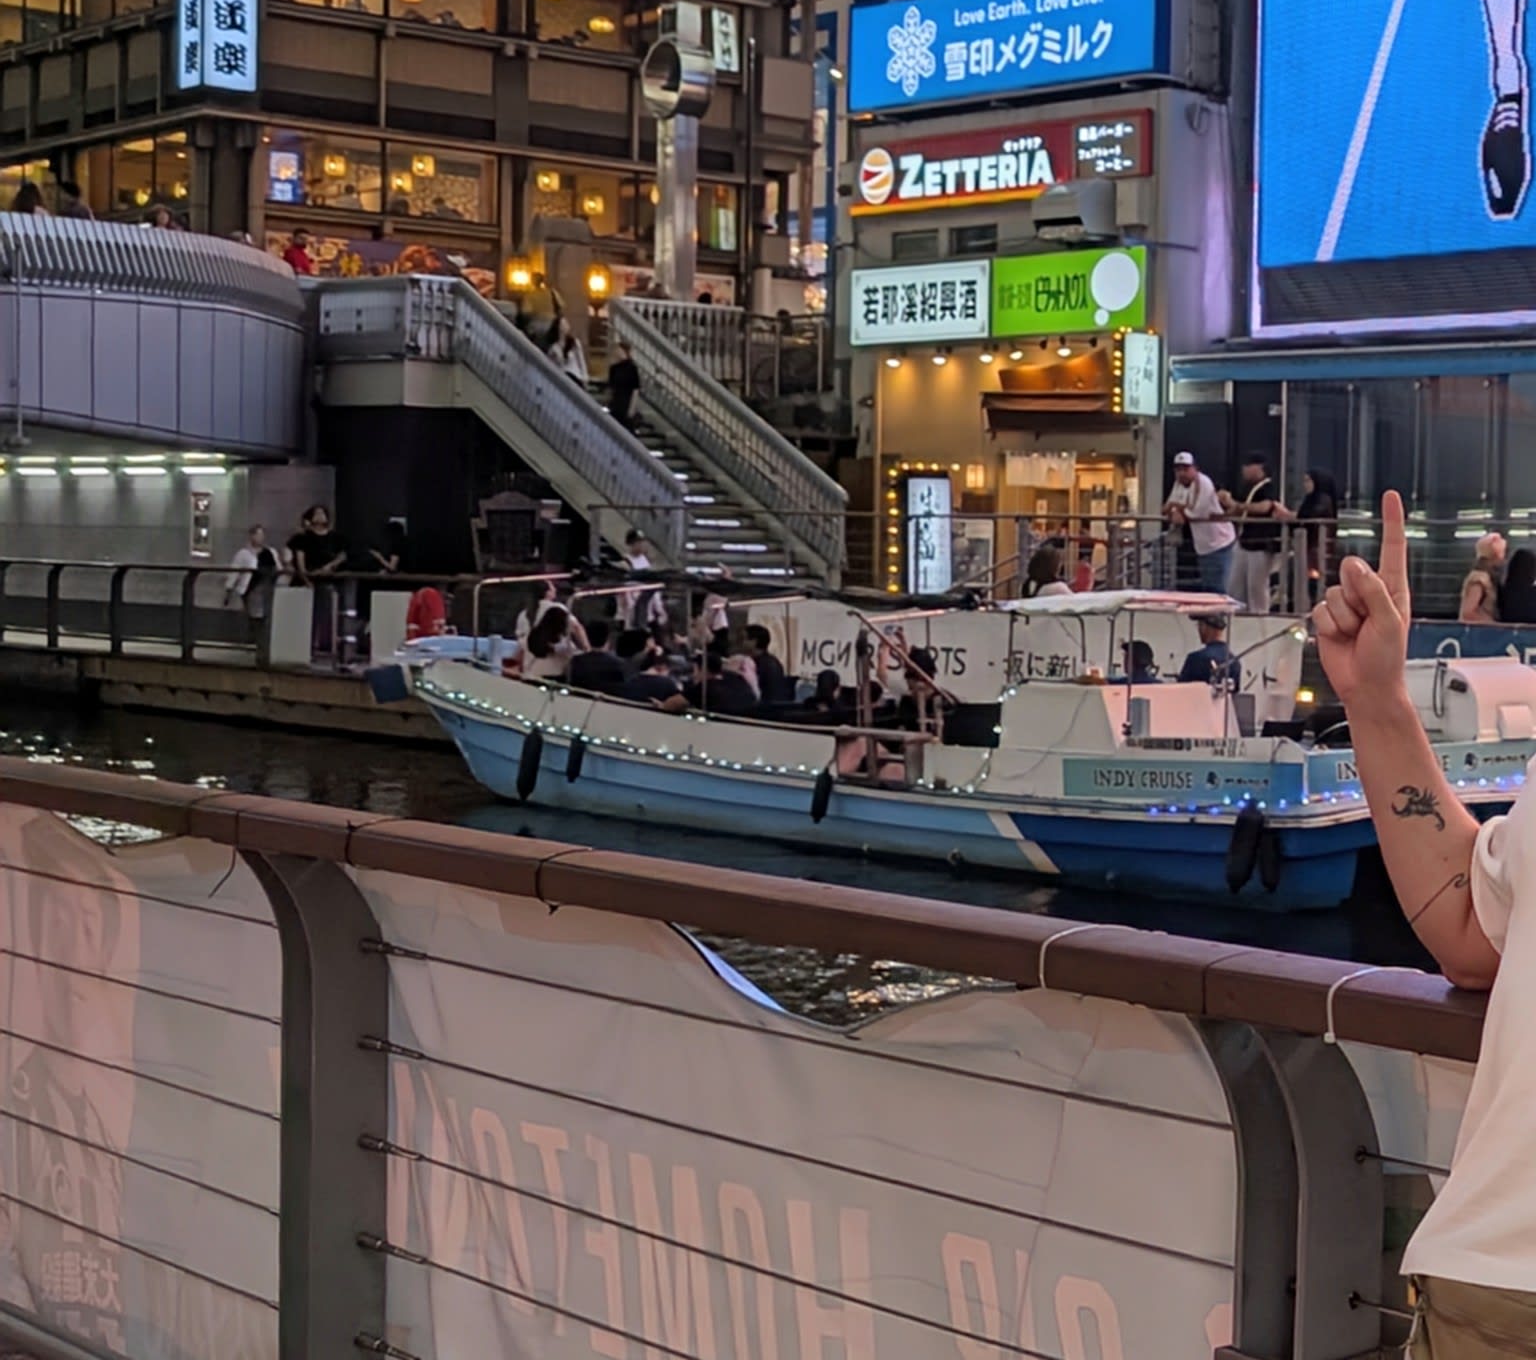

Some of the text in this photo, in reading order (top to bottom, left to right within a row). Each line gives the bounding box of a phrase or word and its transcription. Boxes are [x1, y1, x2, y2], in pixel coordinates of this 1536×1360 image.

[953, 4, 986, 27] Love
[943, 19, 1113, 83] 雪印メグミルク
[898, 149, 1055, 200] ZETTERIA
[1094, 769, 1193, 789] INDY CRUISE
